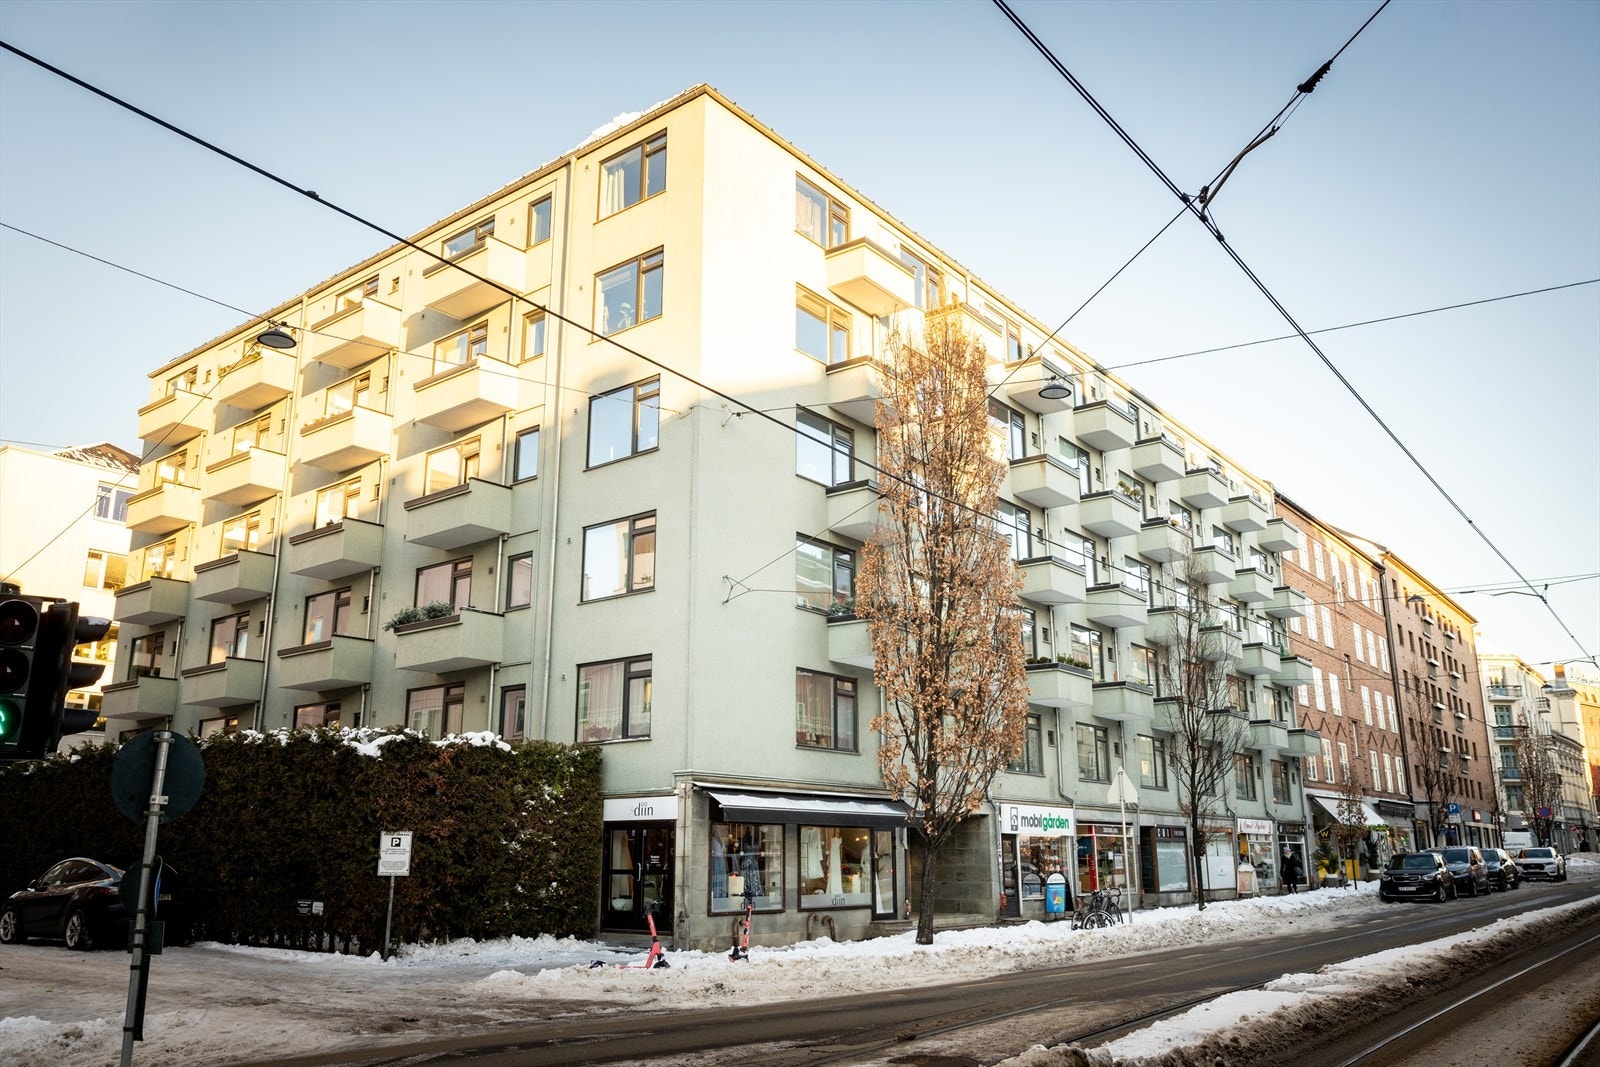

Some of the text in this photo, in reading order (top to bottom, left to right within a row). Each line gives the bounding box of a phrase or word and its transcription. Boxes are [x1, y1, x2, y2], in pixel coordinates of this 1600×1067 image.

[634, 802, 654, 816] diin
[1021, 813, 1070, 832] mobilgården
[392, 838, 400, 847] P
